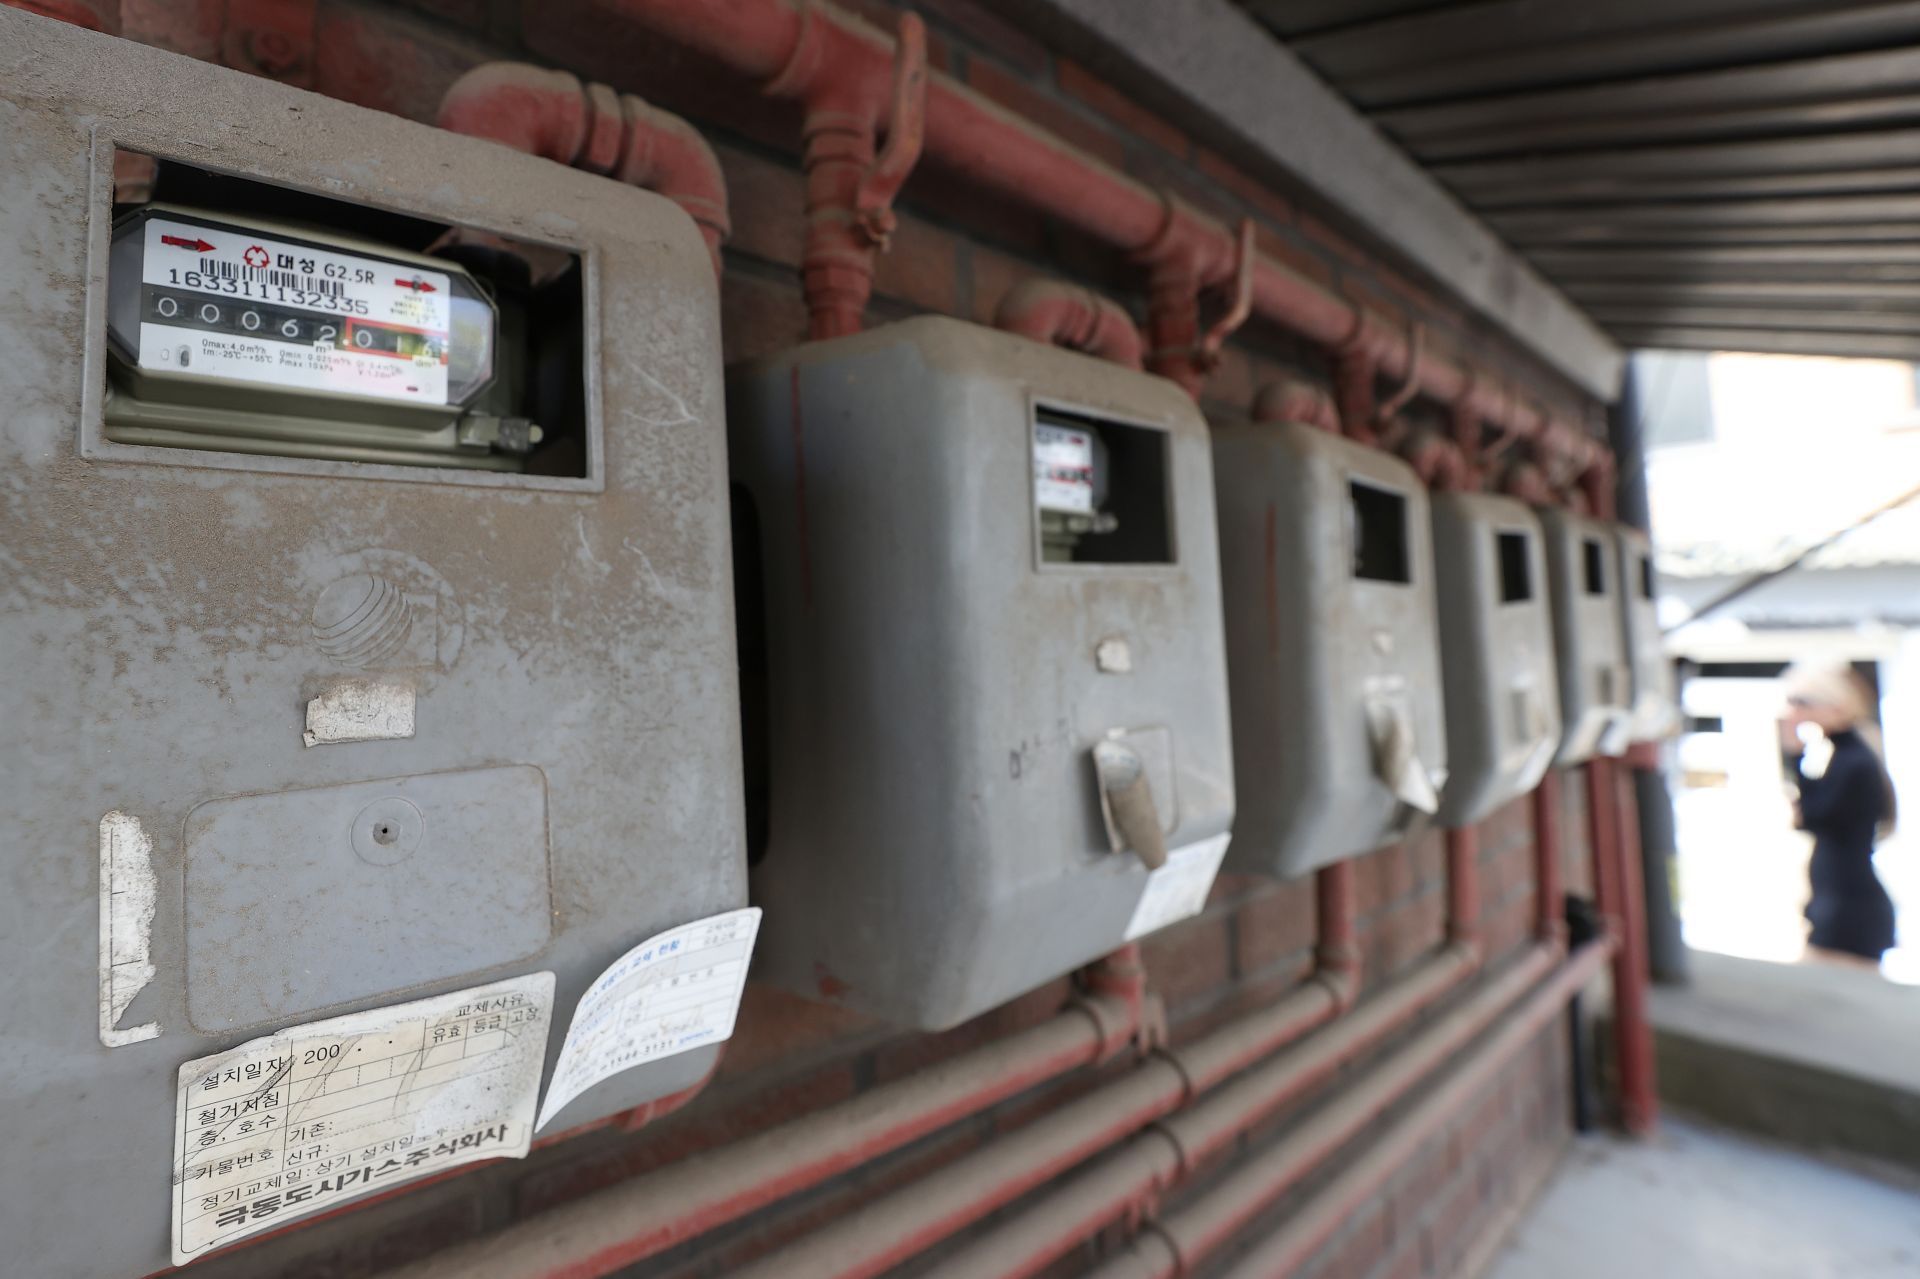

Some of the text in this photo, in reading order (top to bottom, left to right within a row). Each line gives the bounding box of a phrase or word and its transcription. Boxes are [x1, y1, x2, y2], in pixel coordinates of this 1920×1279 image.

[277, 253, 375, 285] 대성 G2.5R
[169, 268, 369, 315] 163311132335
[455, 993, 524, 1018] 교체사유
[432, 1007, 539, 1043] 유효 등급 고장
[201, 1044, 340, 1091] 설치일자 200
[198, 1091, 279, 1126] 철거지침
[236, 1114, 277, 1135] 호수
[196, 1148, 274, 1180] 기물번호
